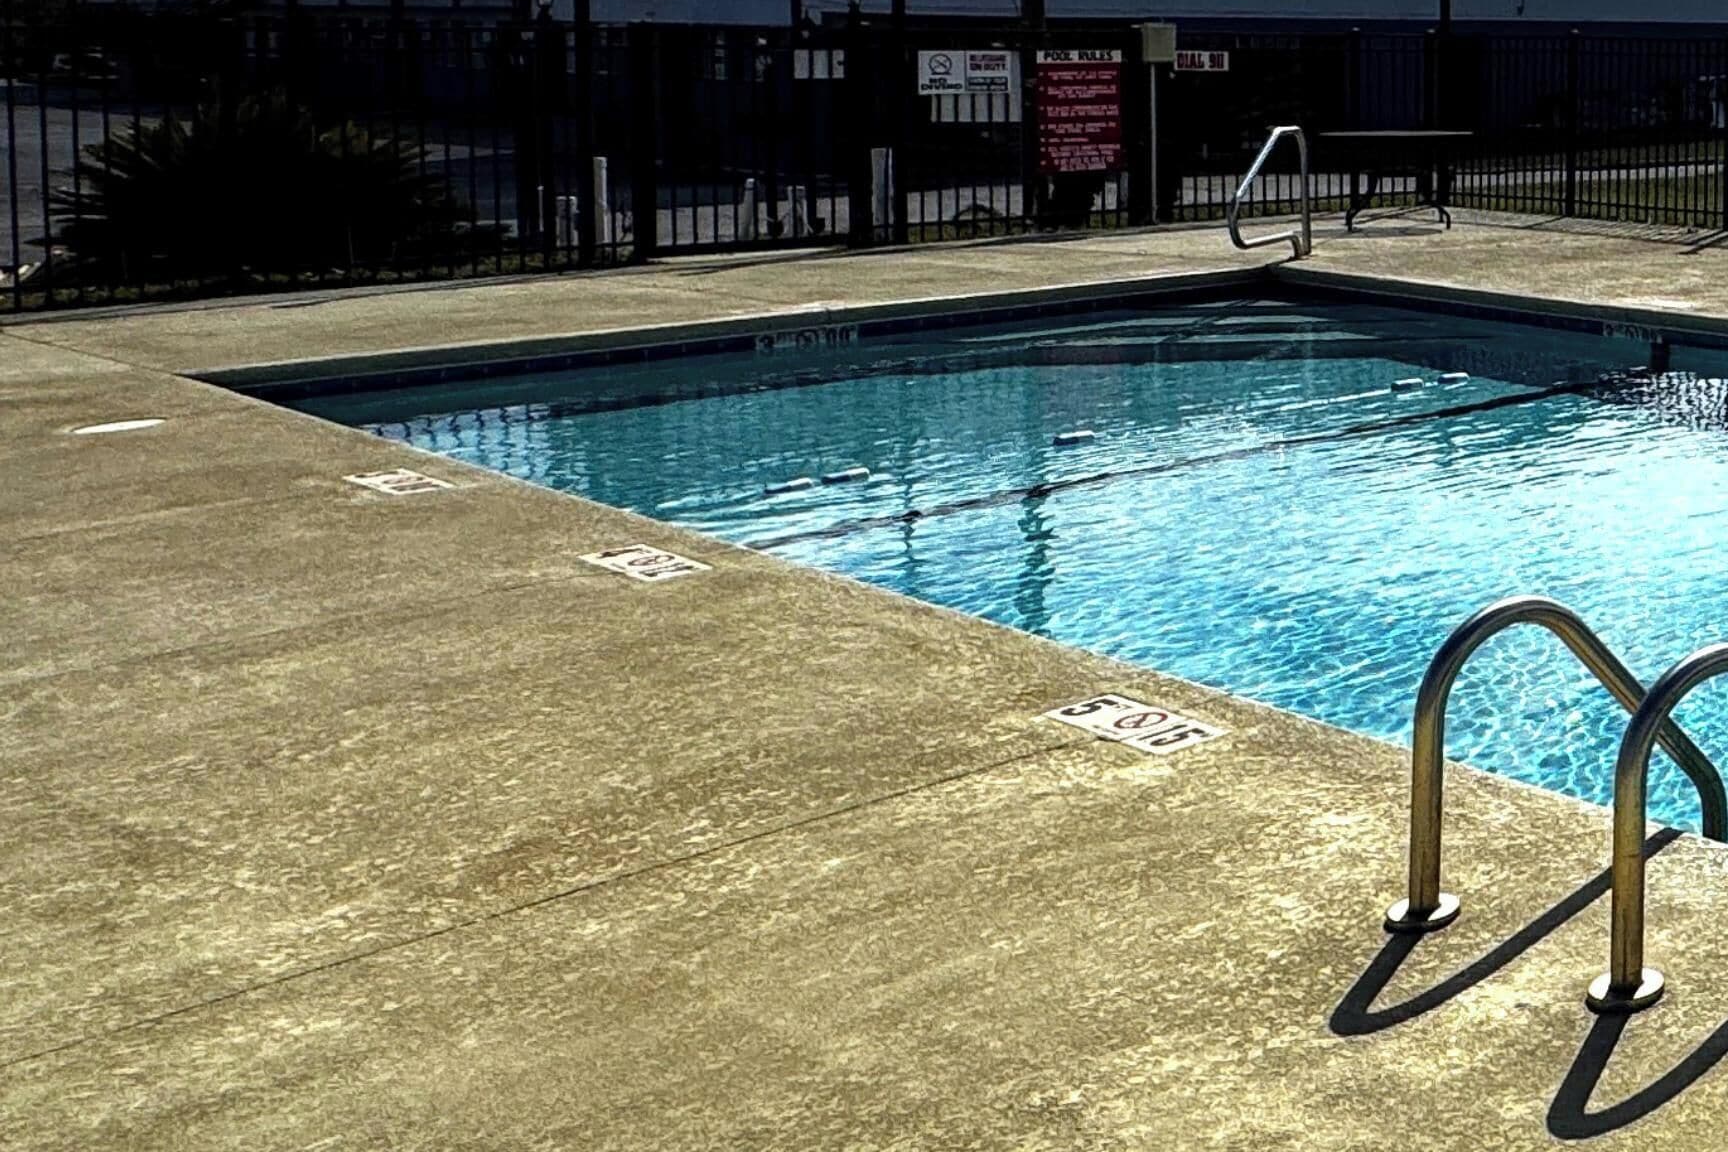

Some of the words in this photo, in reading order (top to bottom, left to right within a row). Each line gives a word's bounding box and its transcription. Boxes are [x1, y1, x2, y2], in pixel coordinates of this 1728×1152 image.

[1043, 49, 1073, 61] POOL
[1078, 49, 1113, 61] RULES
[1177, 52, 1205, 69] DIAL
[1208, 52, 1225, 69] 911
[920, 83, 963, 91] DIVING
[1059, 698, 1119, 716] 5
